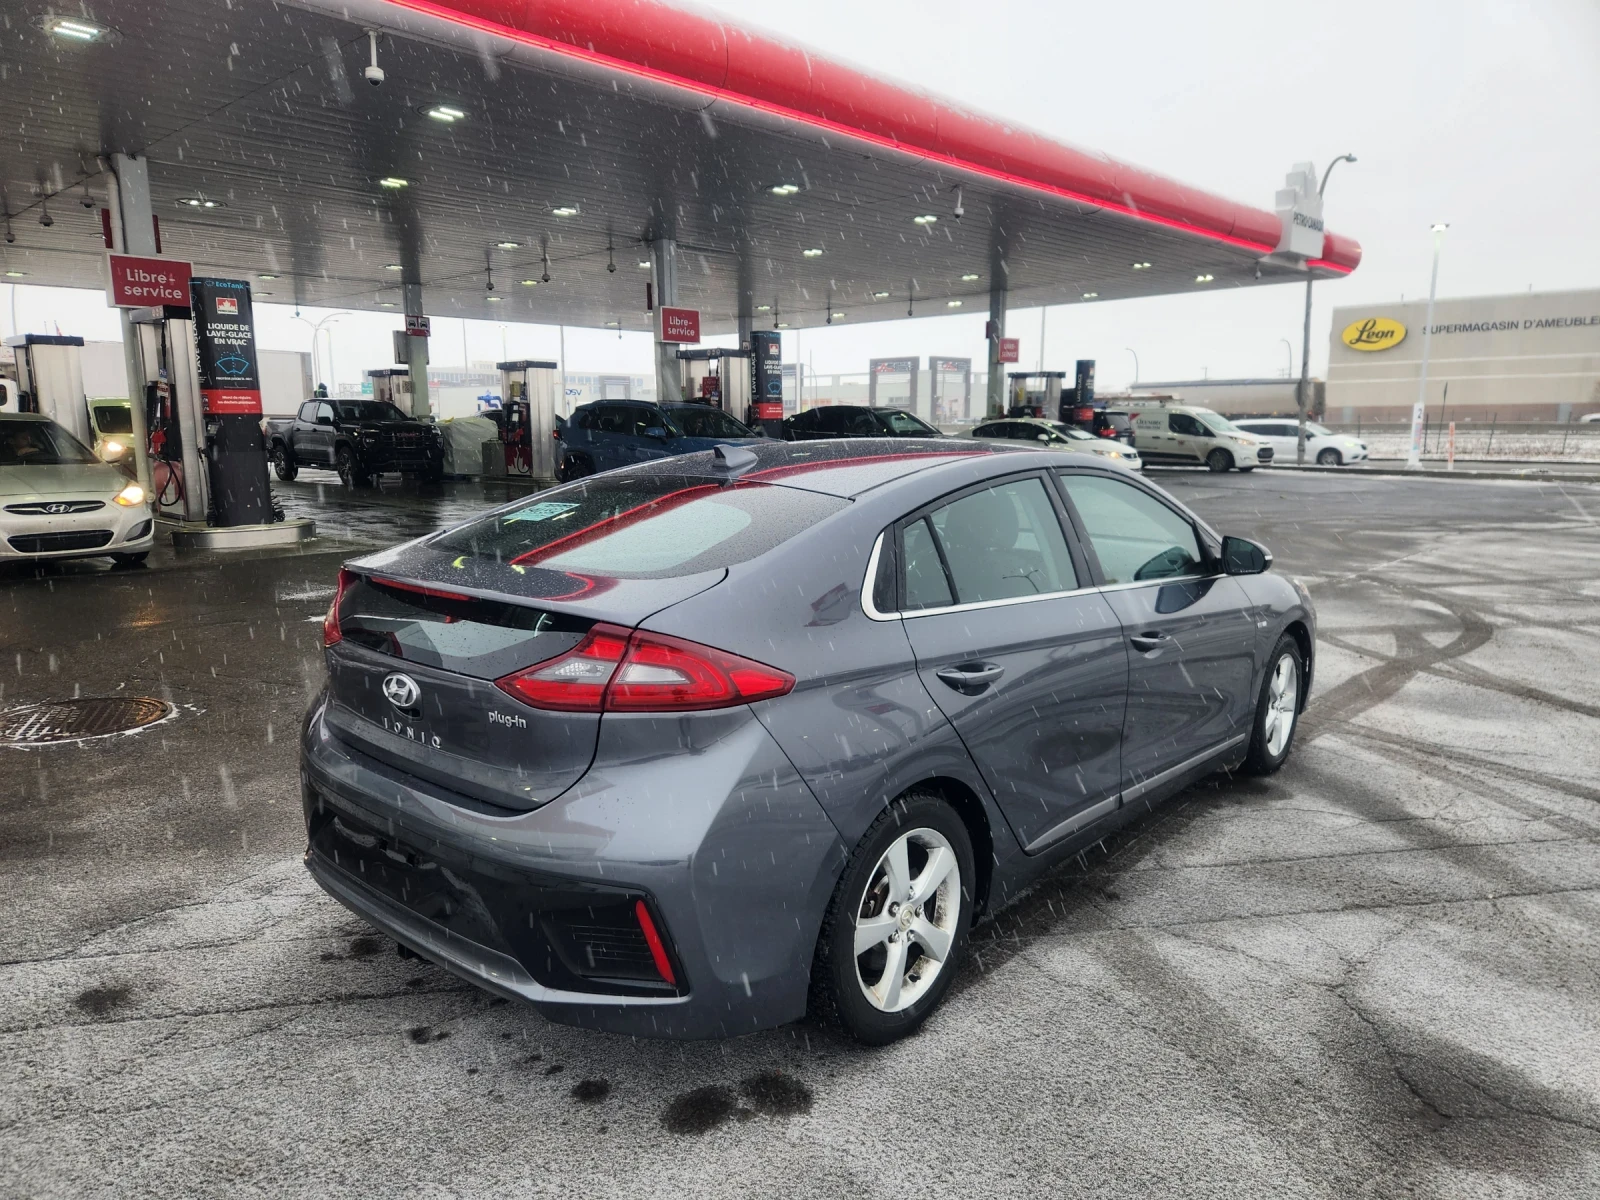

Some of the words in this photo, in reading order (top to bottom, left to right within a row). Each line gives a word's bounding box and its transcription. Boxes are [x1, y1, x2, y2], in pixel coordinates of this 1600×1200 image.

[126, 268, 175, 284] Libre-
[124, 285, 182, 299] service
[216, 281, 243, 289] EcoTank
[669, 316, 693, 326] Libre-
[1523, 315, 1600, 331] D'AMEUBLE
[206, 330, 252, 339] LAVE-GLACE
[667, 326, 695, 336] service
[488, 711, 527, 729] plug-in
[383, 717, 441, 749] IONIQ
